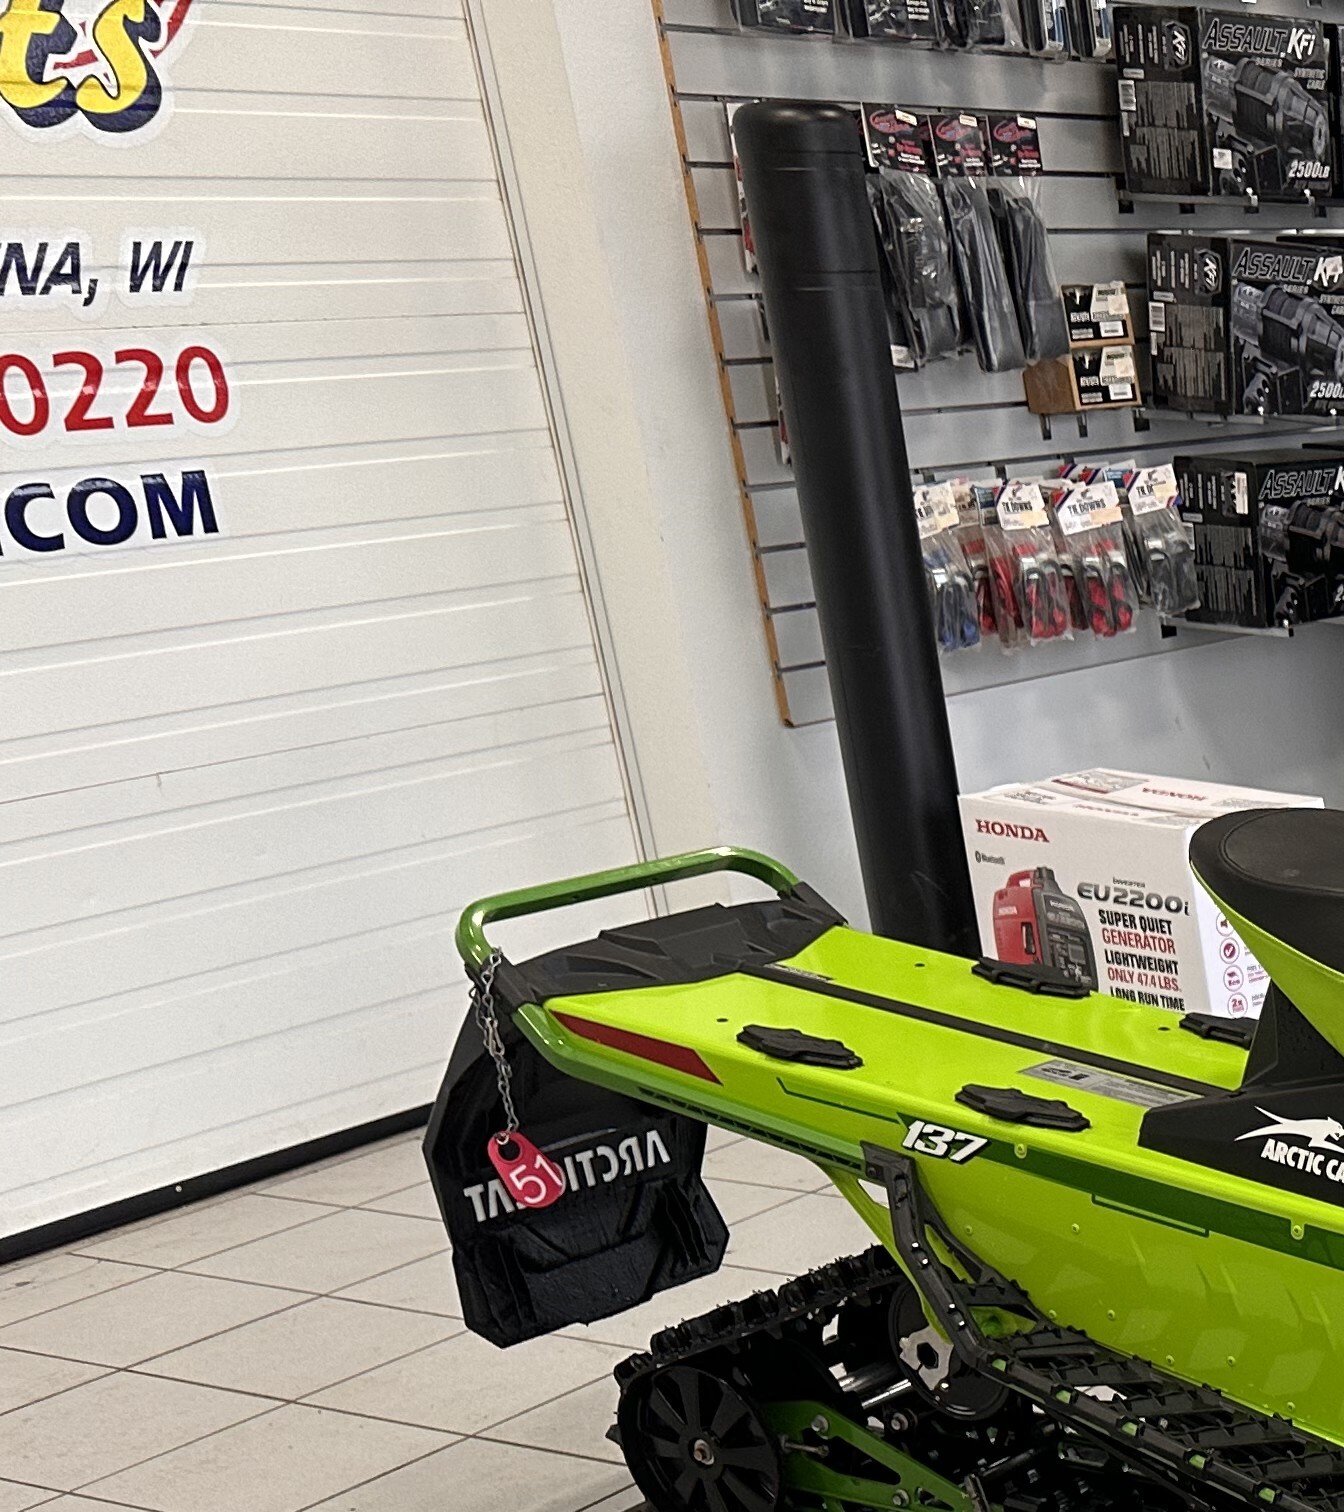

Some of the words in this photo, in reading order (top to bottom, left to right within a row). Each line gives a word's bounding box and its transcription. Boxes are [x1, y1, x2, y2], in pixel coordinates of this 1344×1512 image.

[1202, 18, 1288, 55] ASSAULT
[1288, 159, 1331, 179] 2500LB
[0, 241, 99, 306] NA,
[128, 240, 194, 293] WI
[1232, 247, 1316, 283] ASSAULT
[0, 345, 229, 437] 0220
[1258, 467, 1337, 499] ASSAULT
[0, 469, 220, 556] COM
[975, 819, 1050, 843] HONDA
[1077, 882, 1190, 917] EU2200i
[1098, 909, 1137, 932] SUPER
[1139, 915, 1172, 936] QUIET
[1101, 927, 1176, 955] GENERATOR
[1104, 948, 1179, 976] LIGHTWEIGHT
[1107, 966, 1135, 984] ONLY
[1158, 978, 1183, 993] LBS.
[1137, 990, 1160, 1007] RUN
[1160, 995, 1186, 1011] TIME
[902, 1119, 989, 1163] 137
[1260, 1137, 1326, 1177] ARCTIC
[509, 1153, 563, 1204] 51
